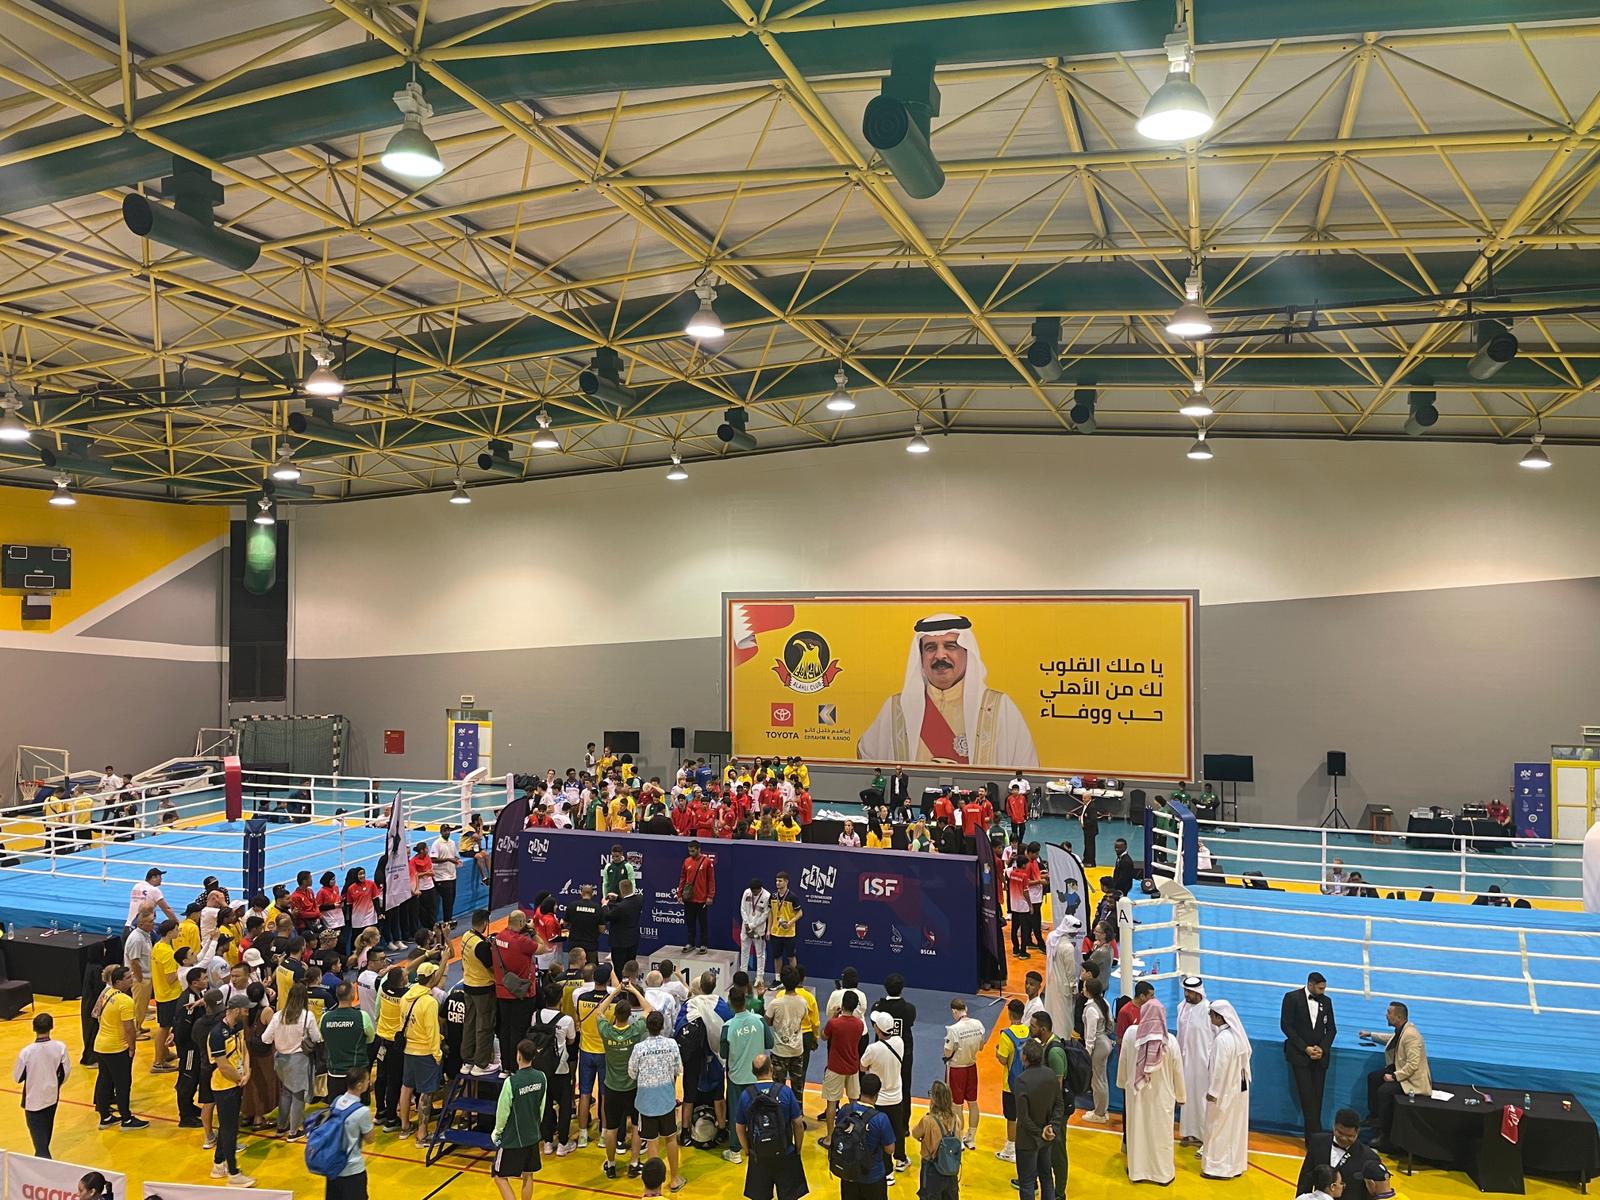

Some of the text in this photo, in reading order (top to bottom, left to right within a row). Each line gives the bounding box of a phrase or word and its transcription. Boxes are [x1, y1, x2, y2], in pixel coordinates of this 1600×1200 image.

[1040, 657, 1164, 678] يا ملك القلوب
[1040, 677, 1163, 703] لك من الأهلي
[765, 731, 799, 739] TOYOTA
[864, 878, 898, 896] ISF
[652, 915, 685, 924] Tamkeen
[1119, 909, 1129, 923] A
[681, 968, 690, 986] 1
[736, 1025, 757, 1037] KSA
[519, 1083, 542, 1096] HUNGARY
